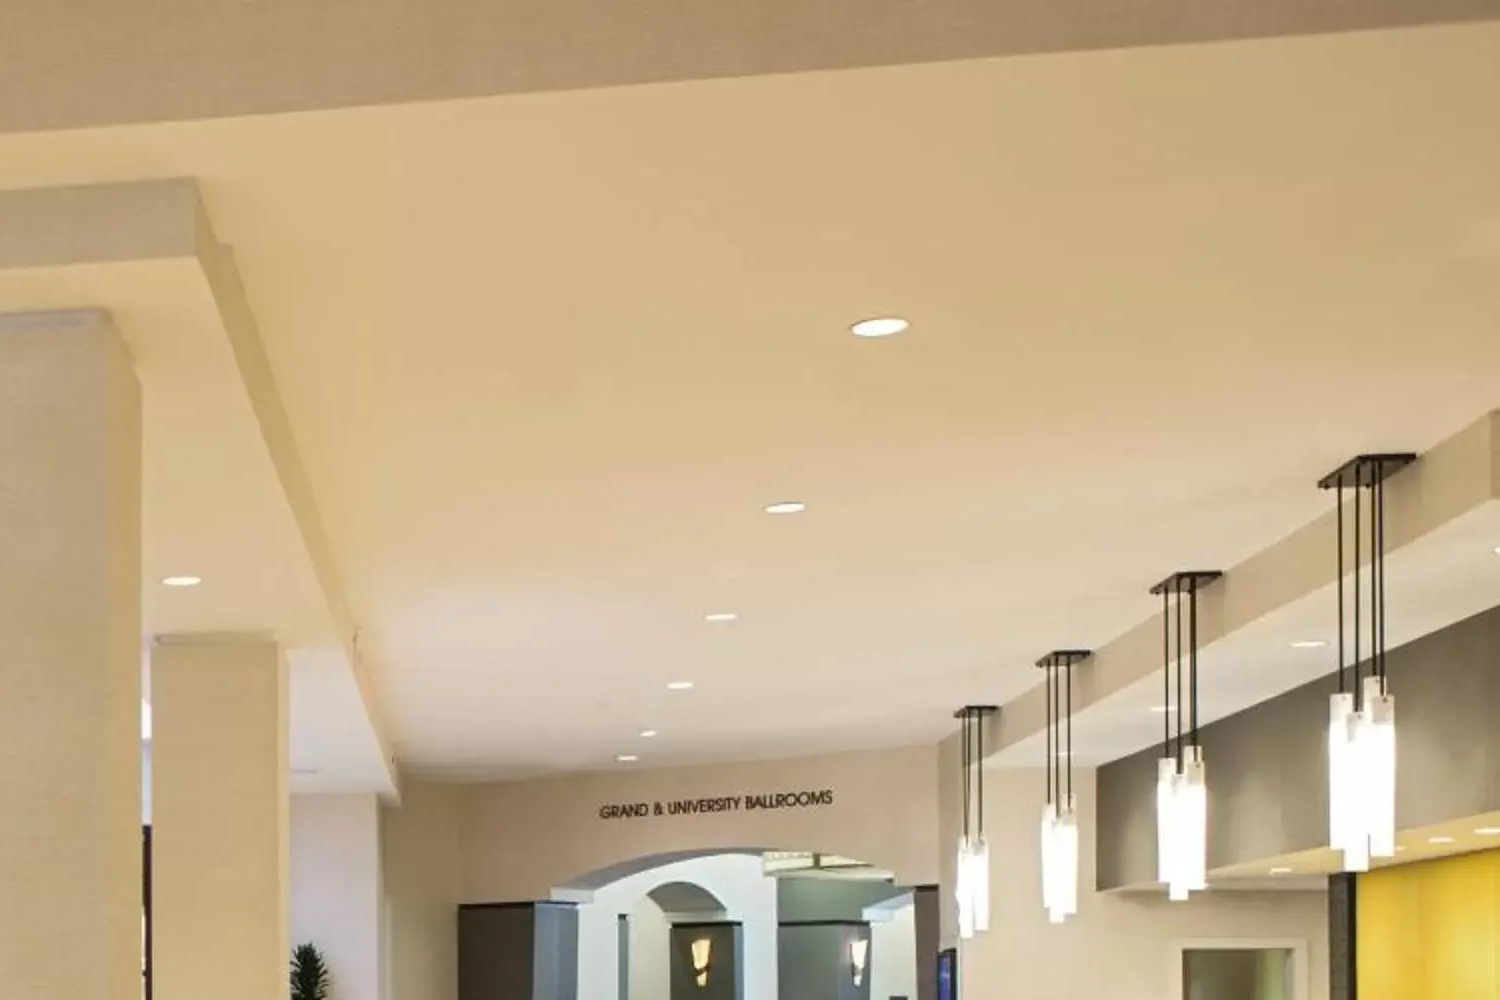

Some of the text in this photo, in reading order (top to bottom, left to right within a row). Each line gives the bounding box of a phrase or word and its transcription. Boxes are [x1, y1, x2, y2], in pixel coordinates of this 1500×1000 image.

[600, 790, 832, 818] GRAND & UNIVERSITY BALLROOMS
